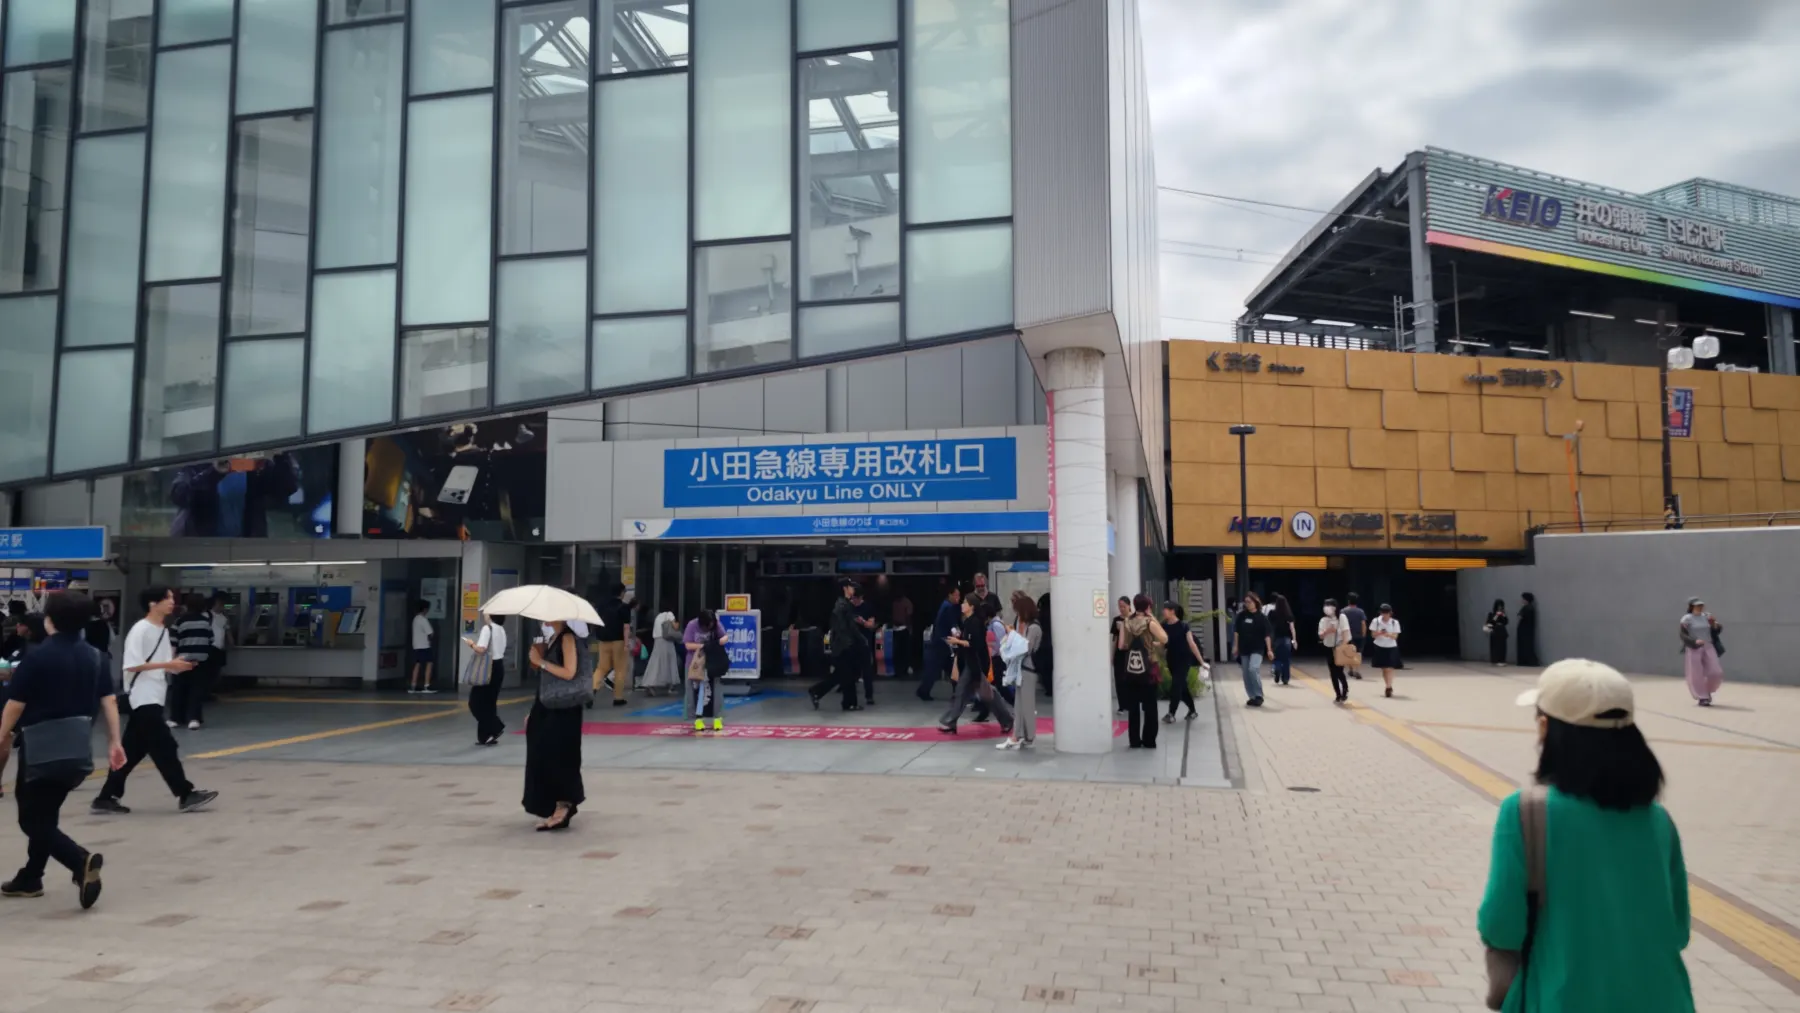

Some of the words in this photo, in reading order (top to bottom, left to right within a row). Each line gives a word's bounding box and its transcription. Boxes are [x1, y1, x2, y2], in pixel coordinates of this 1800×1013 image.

[1480, 185, 1562, 229] KEIO
[1575, 196, 1649, 235] 井の頭線
[1661, 215, 1726, 251] 下北沢駅
[1577, 228, 1630, 250] Inokashira
[1631, 235, 1651, 256] Line
[1734, 259, 1765, 277] Station
[690, 443, 985, 482] 小田急線専用改札口
[747, 486, 817, 504] Odakyu
[824, 485, 863, 501] Line
[869, 482, 926, 499] ONLY
[812, 516, 872, 528] 小田急線のりば
[1297, 519, 1312, 531] IN
[726, 628, 755, 643] 田急線の
[726, 648, 757, 663] 札口です
